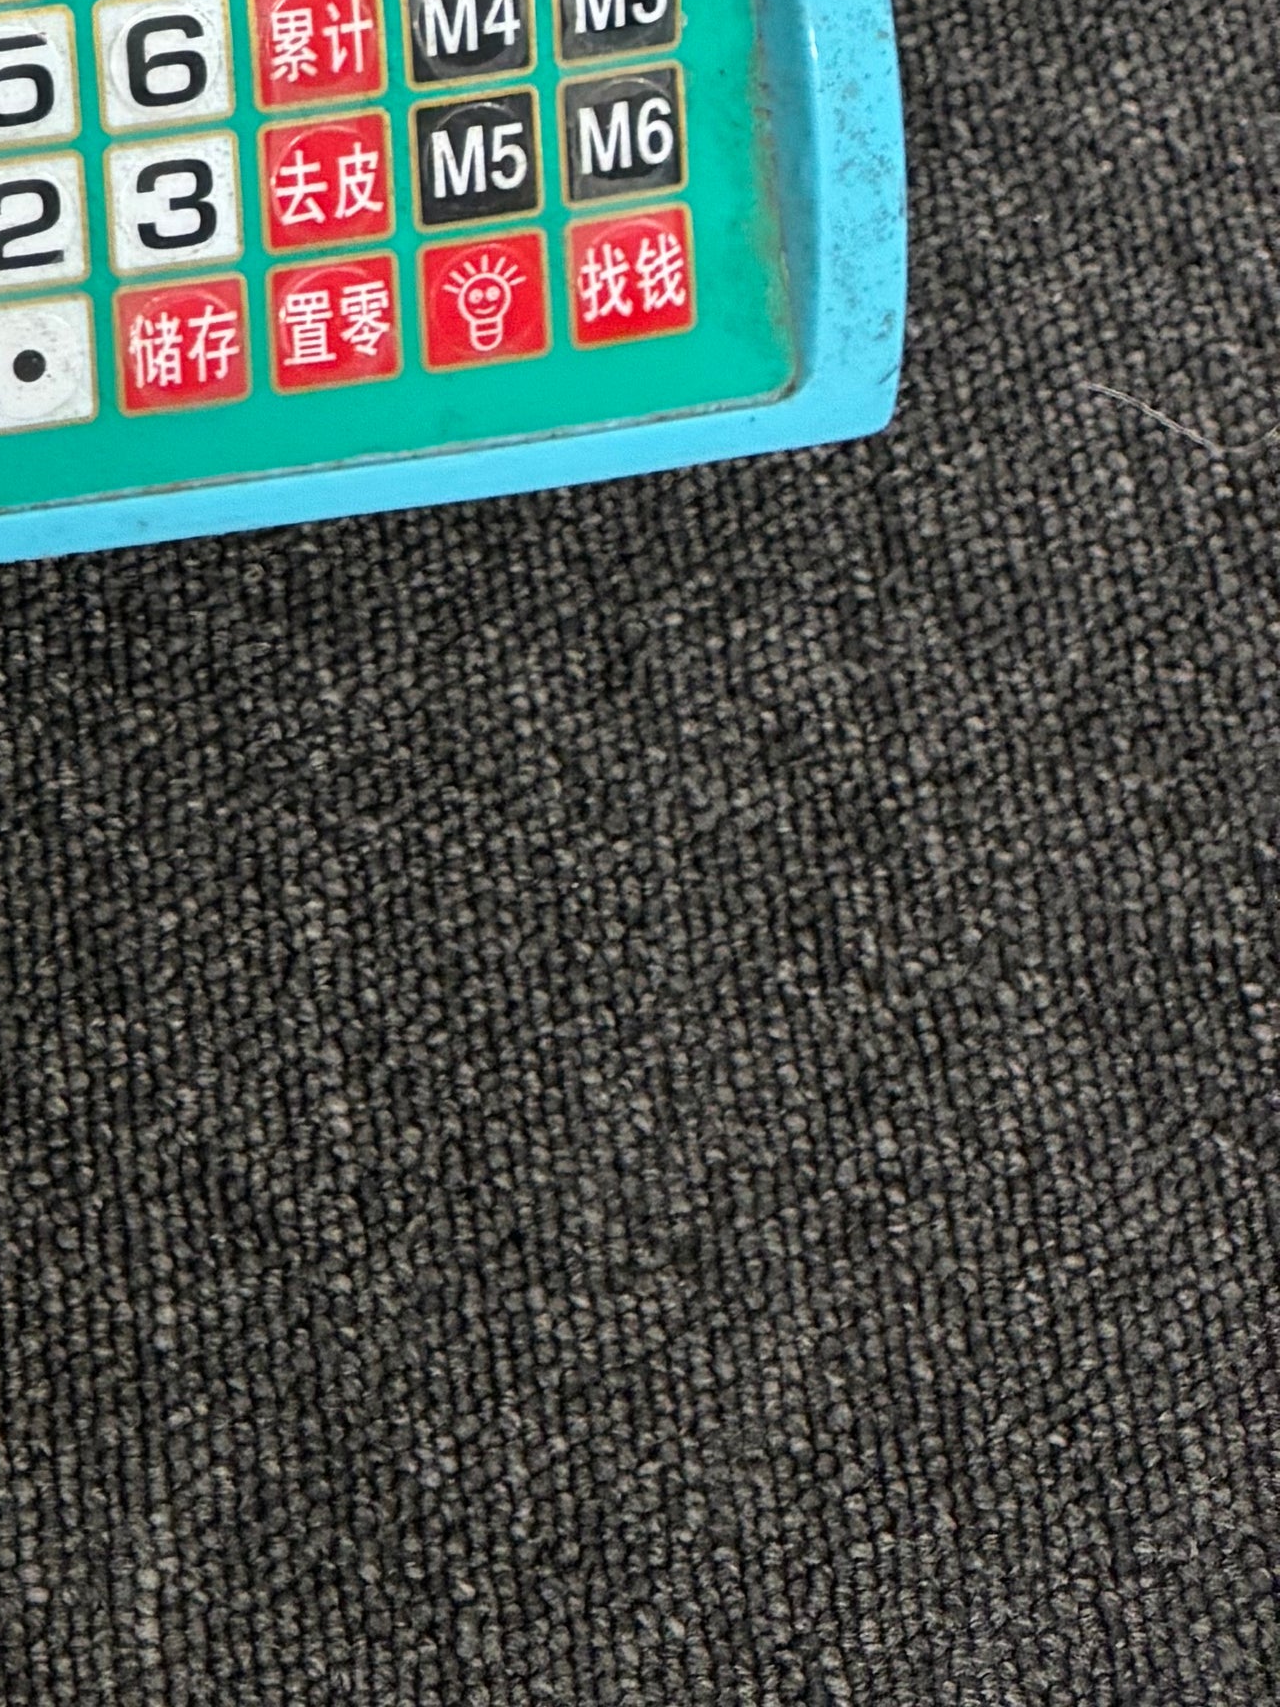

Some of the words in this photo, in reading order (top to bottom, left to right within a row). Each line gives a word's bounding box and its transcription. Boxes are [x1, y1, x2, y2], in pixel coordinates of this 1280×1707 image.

[126, 14, 207, 107] 6
[136, 158, 218, 250] 3
[272, 141, 385, 227] 去皮
[430, 122, 528, 200] M5
[578, 97, 674, 176] M6
[128, 304, 241, 389] 储存
[279, 279, 392, 367] 置零
[578, 230, 686, 323] 找钱
